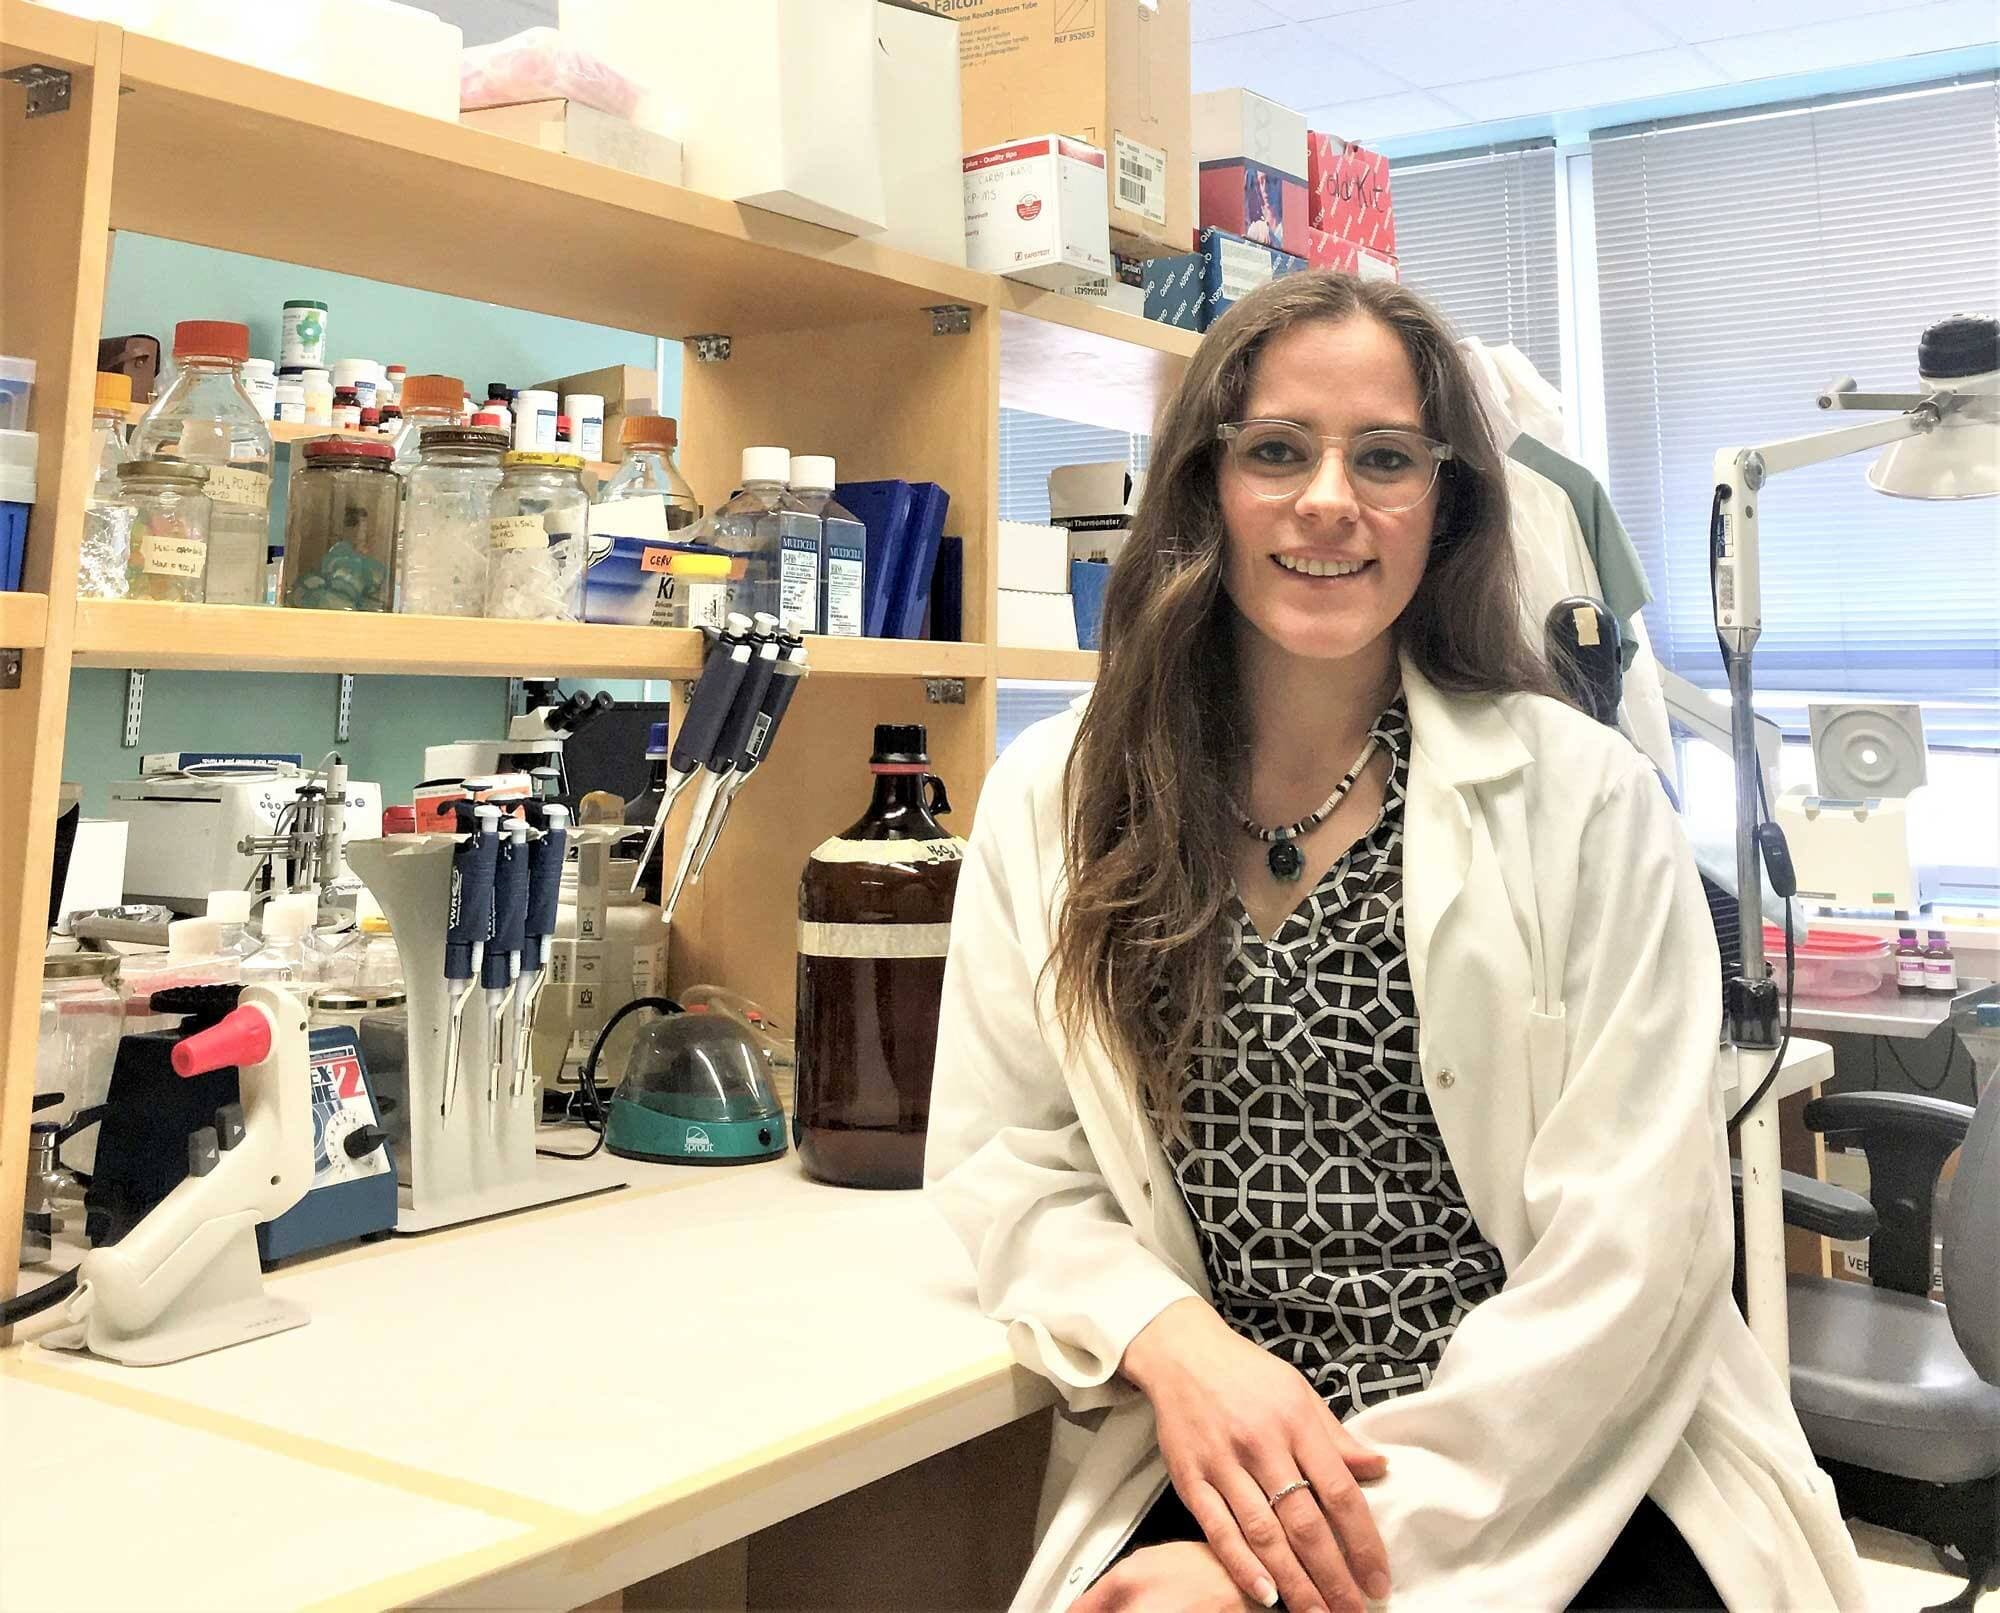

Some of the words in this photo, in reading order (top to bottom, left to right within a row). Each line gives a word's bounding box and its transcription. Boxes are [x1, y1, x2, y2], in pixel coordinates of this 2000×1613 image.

[972, 5, 1020, 20] Round-Bottom
[1021, 1, 1038, 11] Tube
[1054, 36, 1067, 44] REF
[1069, 31, 1095, 42] 352053
[983, 152, 1004, 164] Quality
[1006, 150, 1017, 160] tips
[1160, 271, 1176, 297] QIAGEN
[1074, 518, 1120, 528] Thermometer
[783, 537, 816, 550] MULTICELL
[830, 546, 861, 560] MULTICELL
[448, 897, 458, 930] VWR
[333, 1060, 366, 1100] 2
[684, 1142, 714, 1154] sprout
